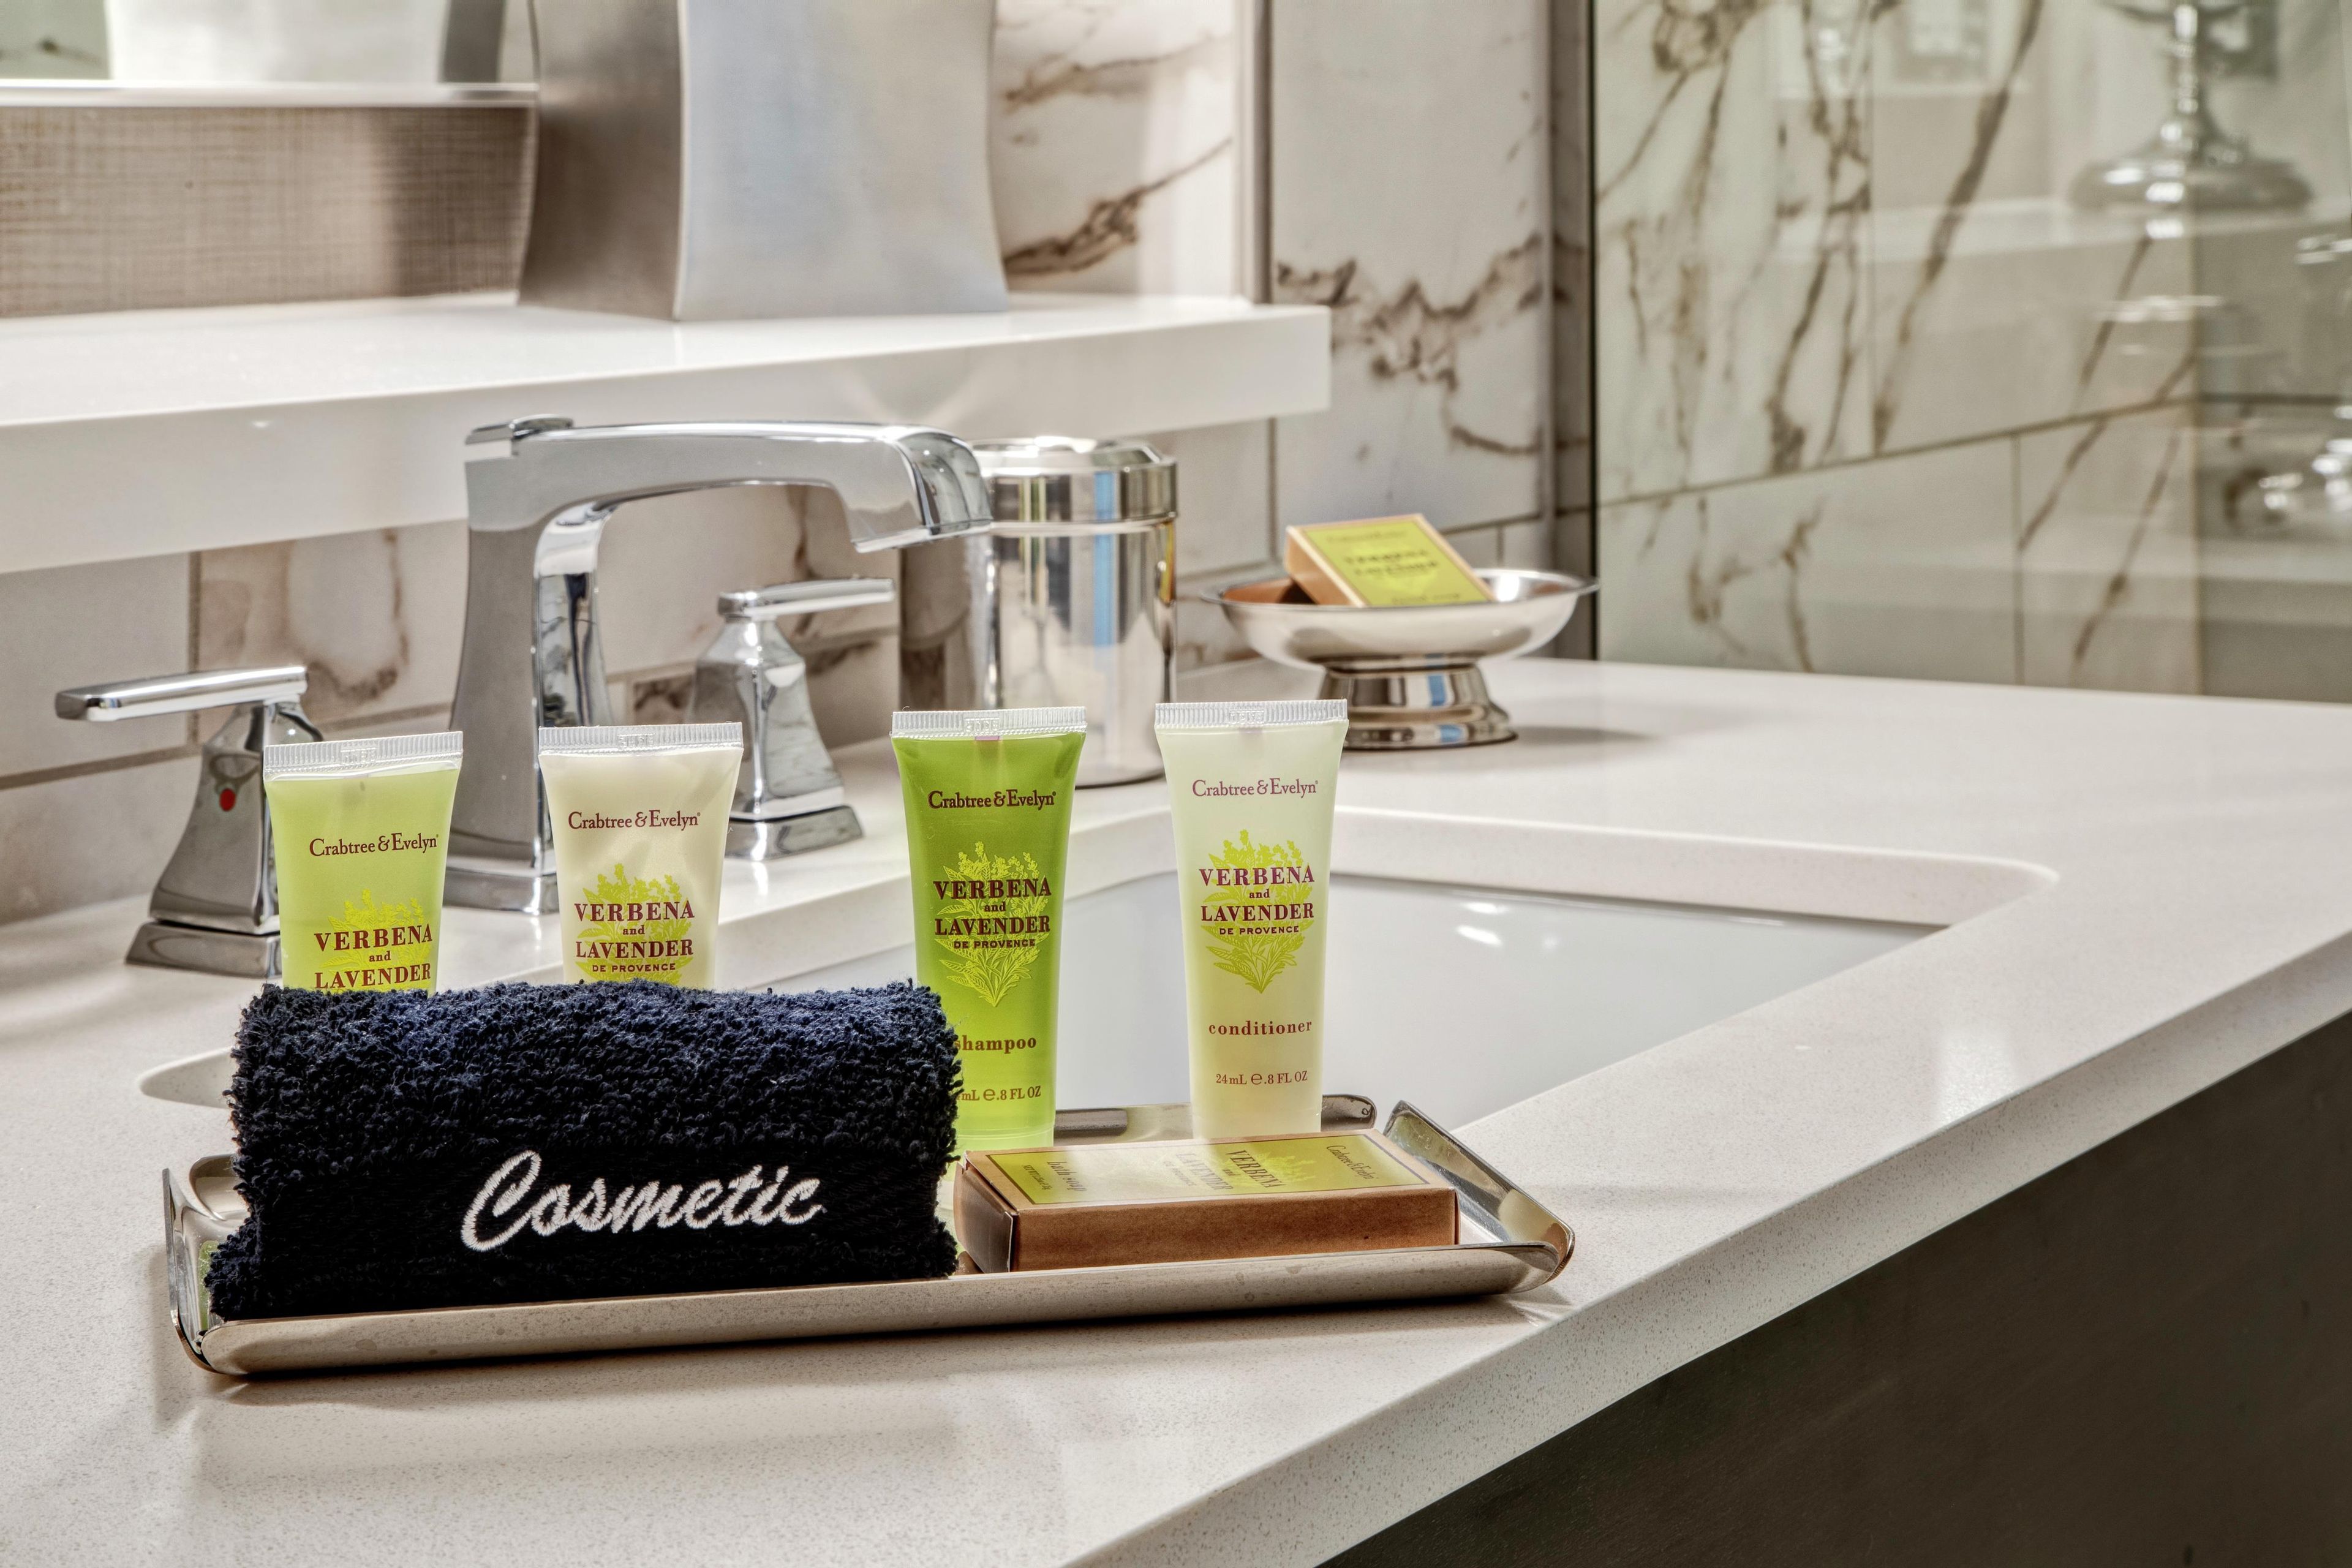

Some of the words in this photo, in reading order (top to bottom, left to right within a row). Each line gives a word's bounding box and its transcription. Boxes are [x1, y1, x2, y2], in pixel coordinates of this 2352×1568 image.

[1192, 780, 1254, 796] Crabtree
[928, 790, 992, 809] Crabtree
[568, 811, 632, 829] Crabtree
[309, 838, 375, 856] Crabtree
[1199, 865, 1314, 886] VERBENA
[933, 877, 1052, 900] VERBENA
[1249, 888, 1270, 899] and
[574, 900, 695, 922] VERBENA
[984, 901, 1006, 912] and
[1200, 903, 1314, 921] LAVENDER
[622, 925, 645, 935] and
[935, 915, 1050, 936] LAVENDER
[1240, 926, 1299, 935] PROVENCE
[314, 924, 432, 952] VERBENA
[974, 939, 1035, 949] PROVENCE
[369, 951, 391, 962] and
[576, 939, 694, 959] LAVENDER
[315, 963, 431, 989] LAVENDER
[612, 963, 676, 972] PROVENCE
[1208, 1020, 1312, 1036] conditioner
[1277, 1073, 1292, 1084] FL
[1294, 1071, 1308, 1082] OZ
[1010, 1088, 1025, 1100] FL
[1027, 1085, 1041, 1098] OZ
[1225, 1150, 1286, 1188] VERBENA
[461, 1150, 823, 1252] Cosmetic
